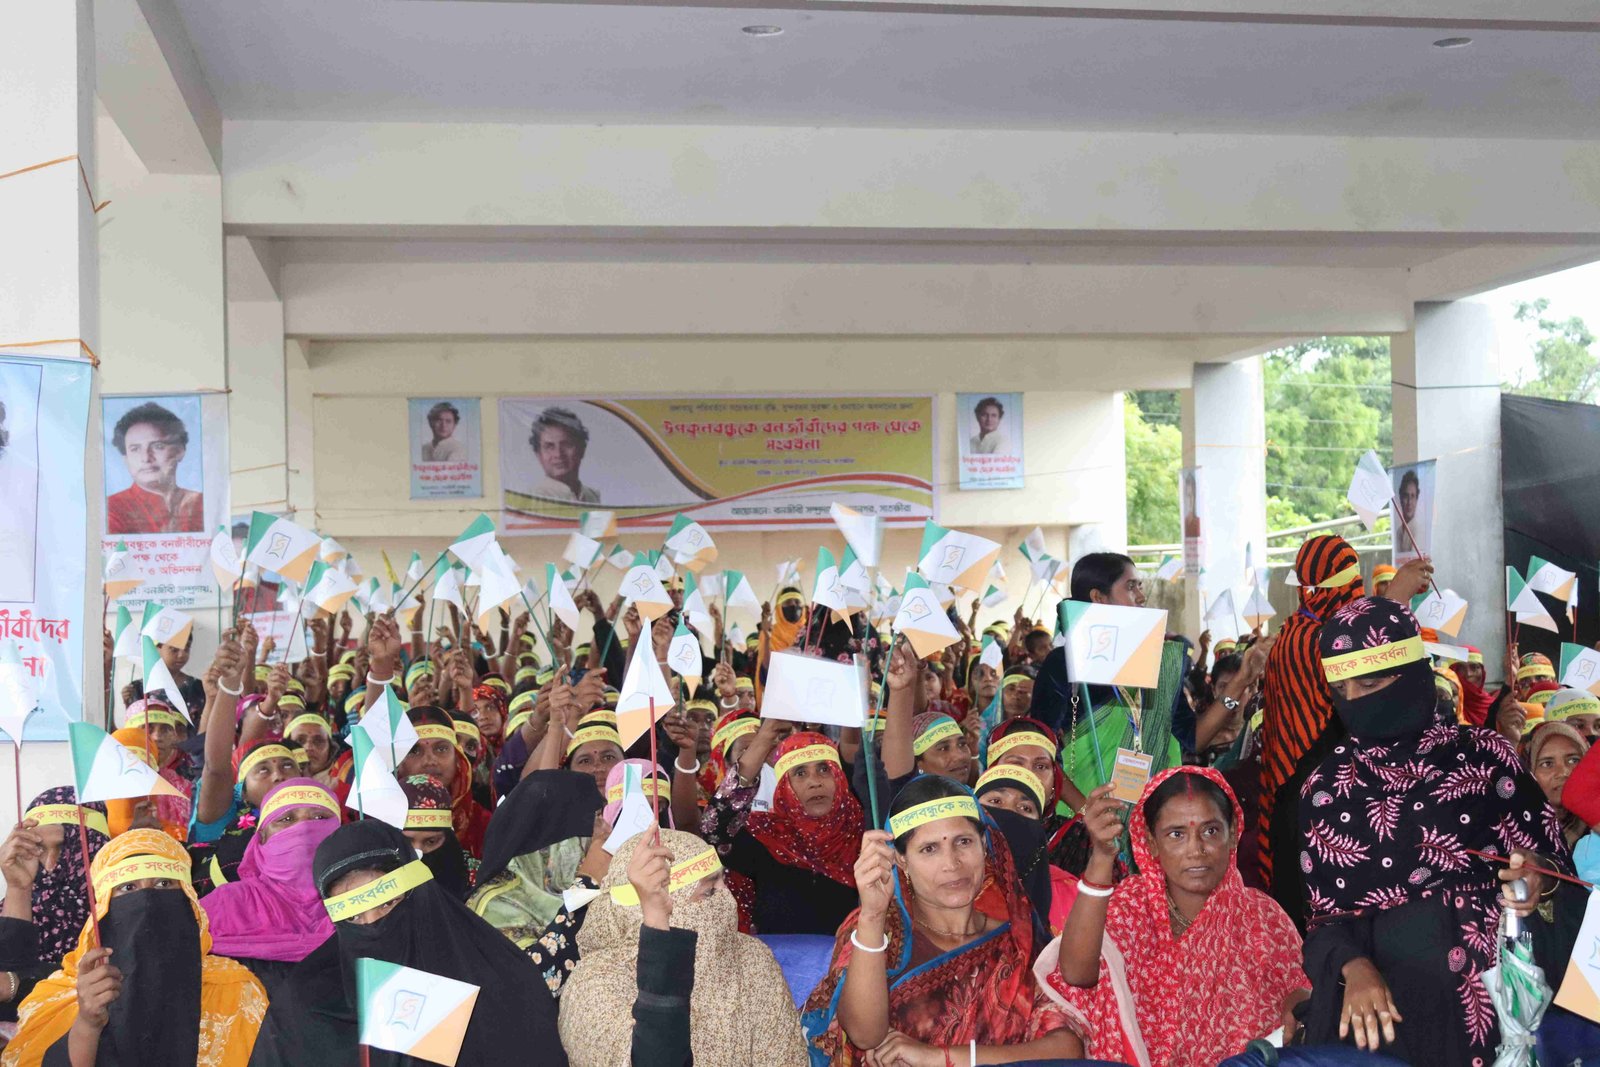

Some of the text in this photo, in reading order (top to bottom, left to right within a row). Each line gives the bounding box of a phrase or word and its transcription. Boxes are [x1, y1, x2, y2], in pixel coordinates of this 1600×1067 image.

[762, 417, 848, 434] বনজীবীদের
[852, 421, 880, 432] পক্ষ
[0, 609, 71, 644] ীবীদের
[1361, 645, 1408, 665] সংবর্ধনা
[892, 801, 956, 829] উপকূলবন্ধুকে
[143, 861, 187, 873] সংবর্ধন
[347, 878, 399, 905] সংবর্ধনা
